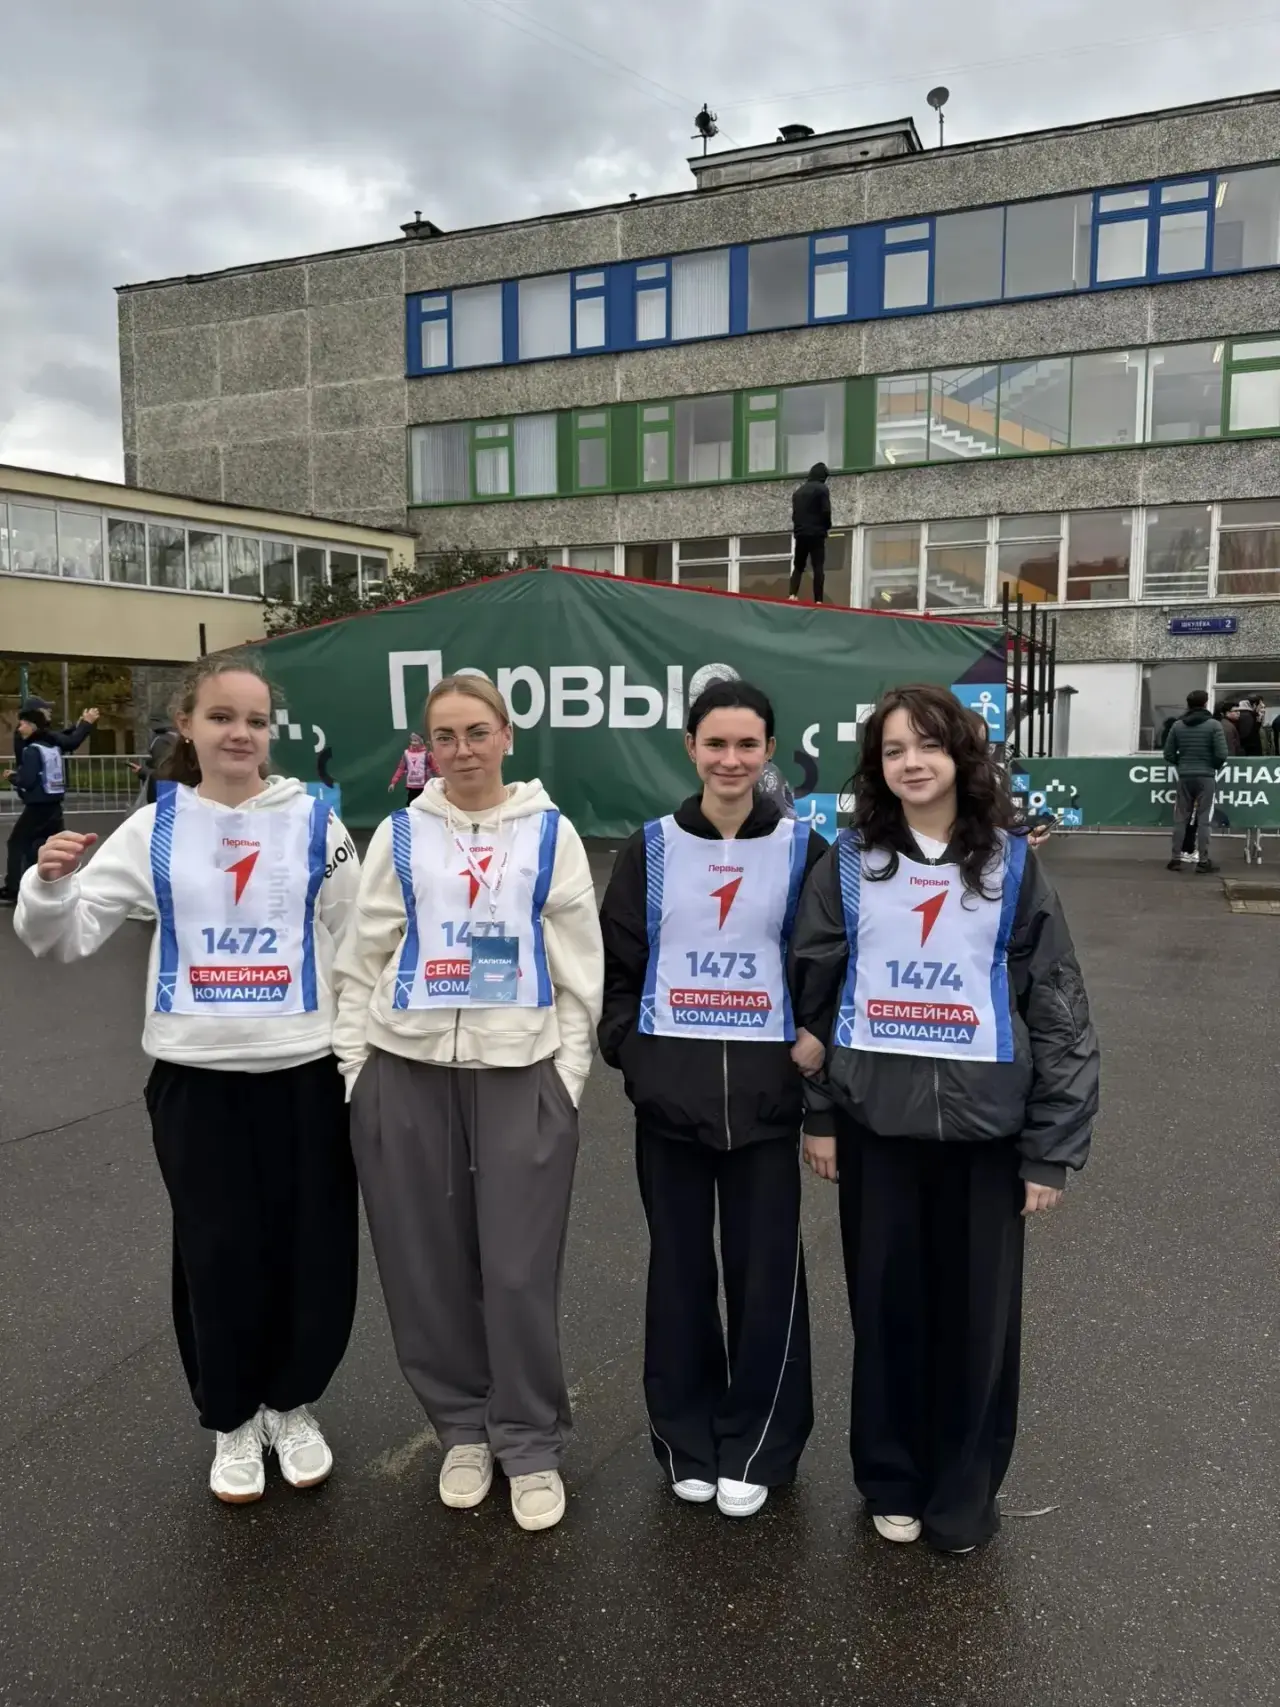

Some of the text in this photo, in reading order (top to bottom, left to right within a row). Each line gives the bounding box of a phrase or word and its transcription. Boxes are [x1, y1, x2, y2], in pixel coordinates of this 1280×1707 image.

[1225, 619, 1232, 628] 2
[388, 649, 742, 756] Првы
[1150, 789, 1270, 807] КОНДА
[222, 838, 260, 848] Первые
[708, 864, 744, 873] Первые
[909, 876, 950, 887] Первые
[202, 927, 278, 954] 1472
[426, 963, 471, 976] СЕМЕ
[685, 951, 758, 980] 1473
[190, 968, 289, 982] СЕМЕЙНАЯ
[885, 960, 964, 992] 1474
[194, 986, 283, 1001] КОМАНДА
[671, 991, 768, 1008] СЕМЕЙНАЯ
[675, 1010, 764, 1025] КОМАНДА
[869, 1003, 975, 1022] СЕМЕЙНАЯ
[873, 1021, 971, 1042] КОМАНДА
